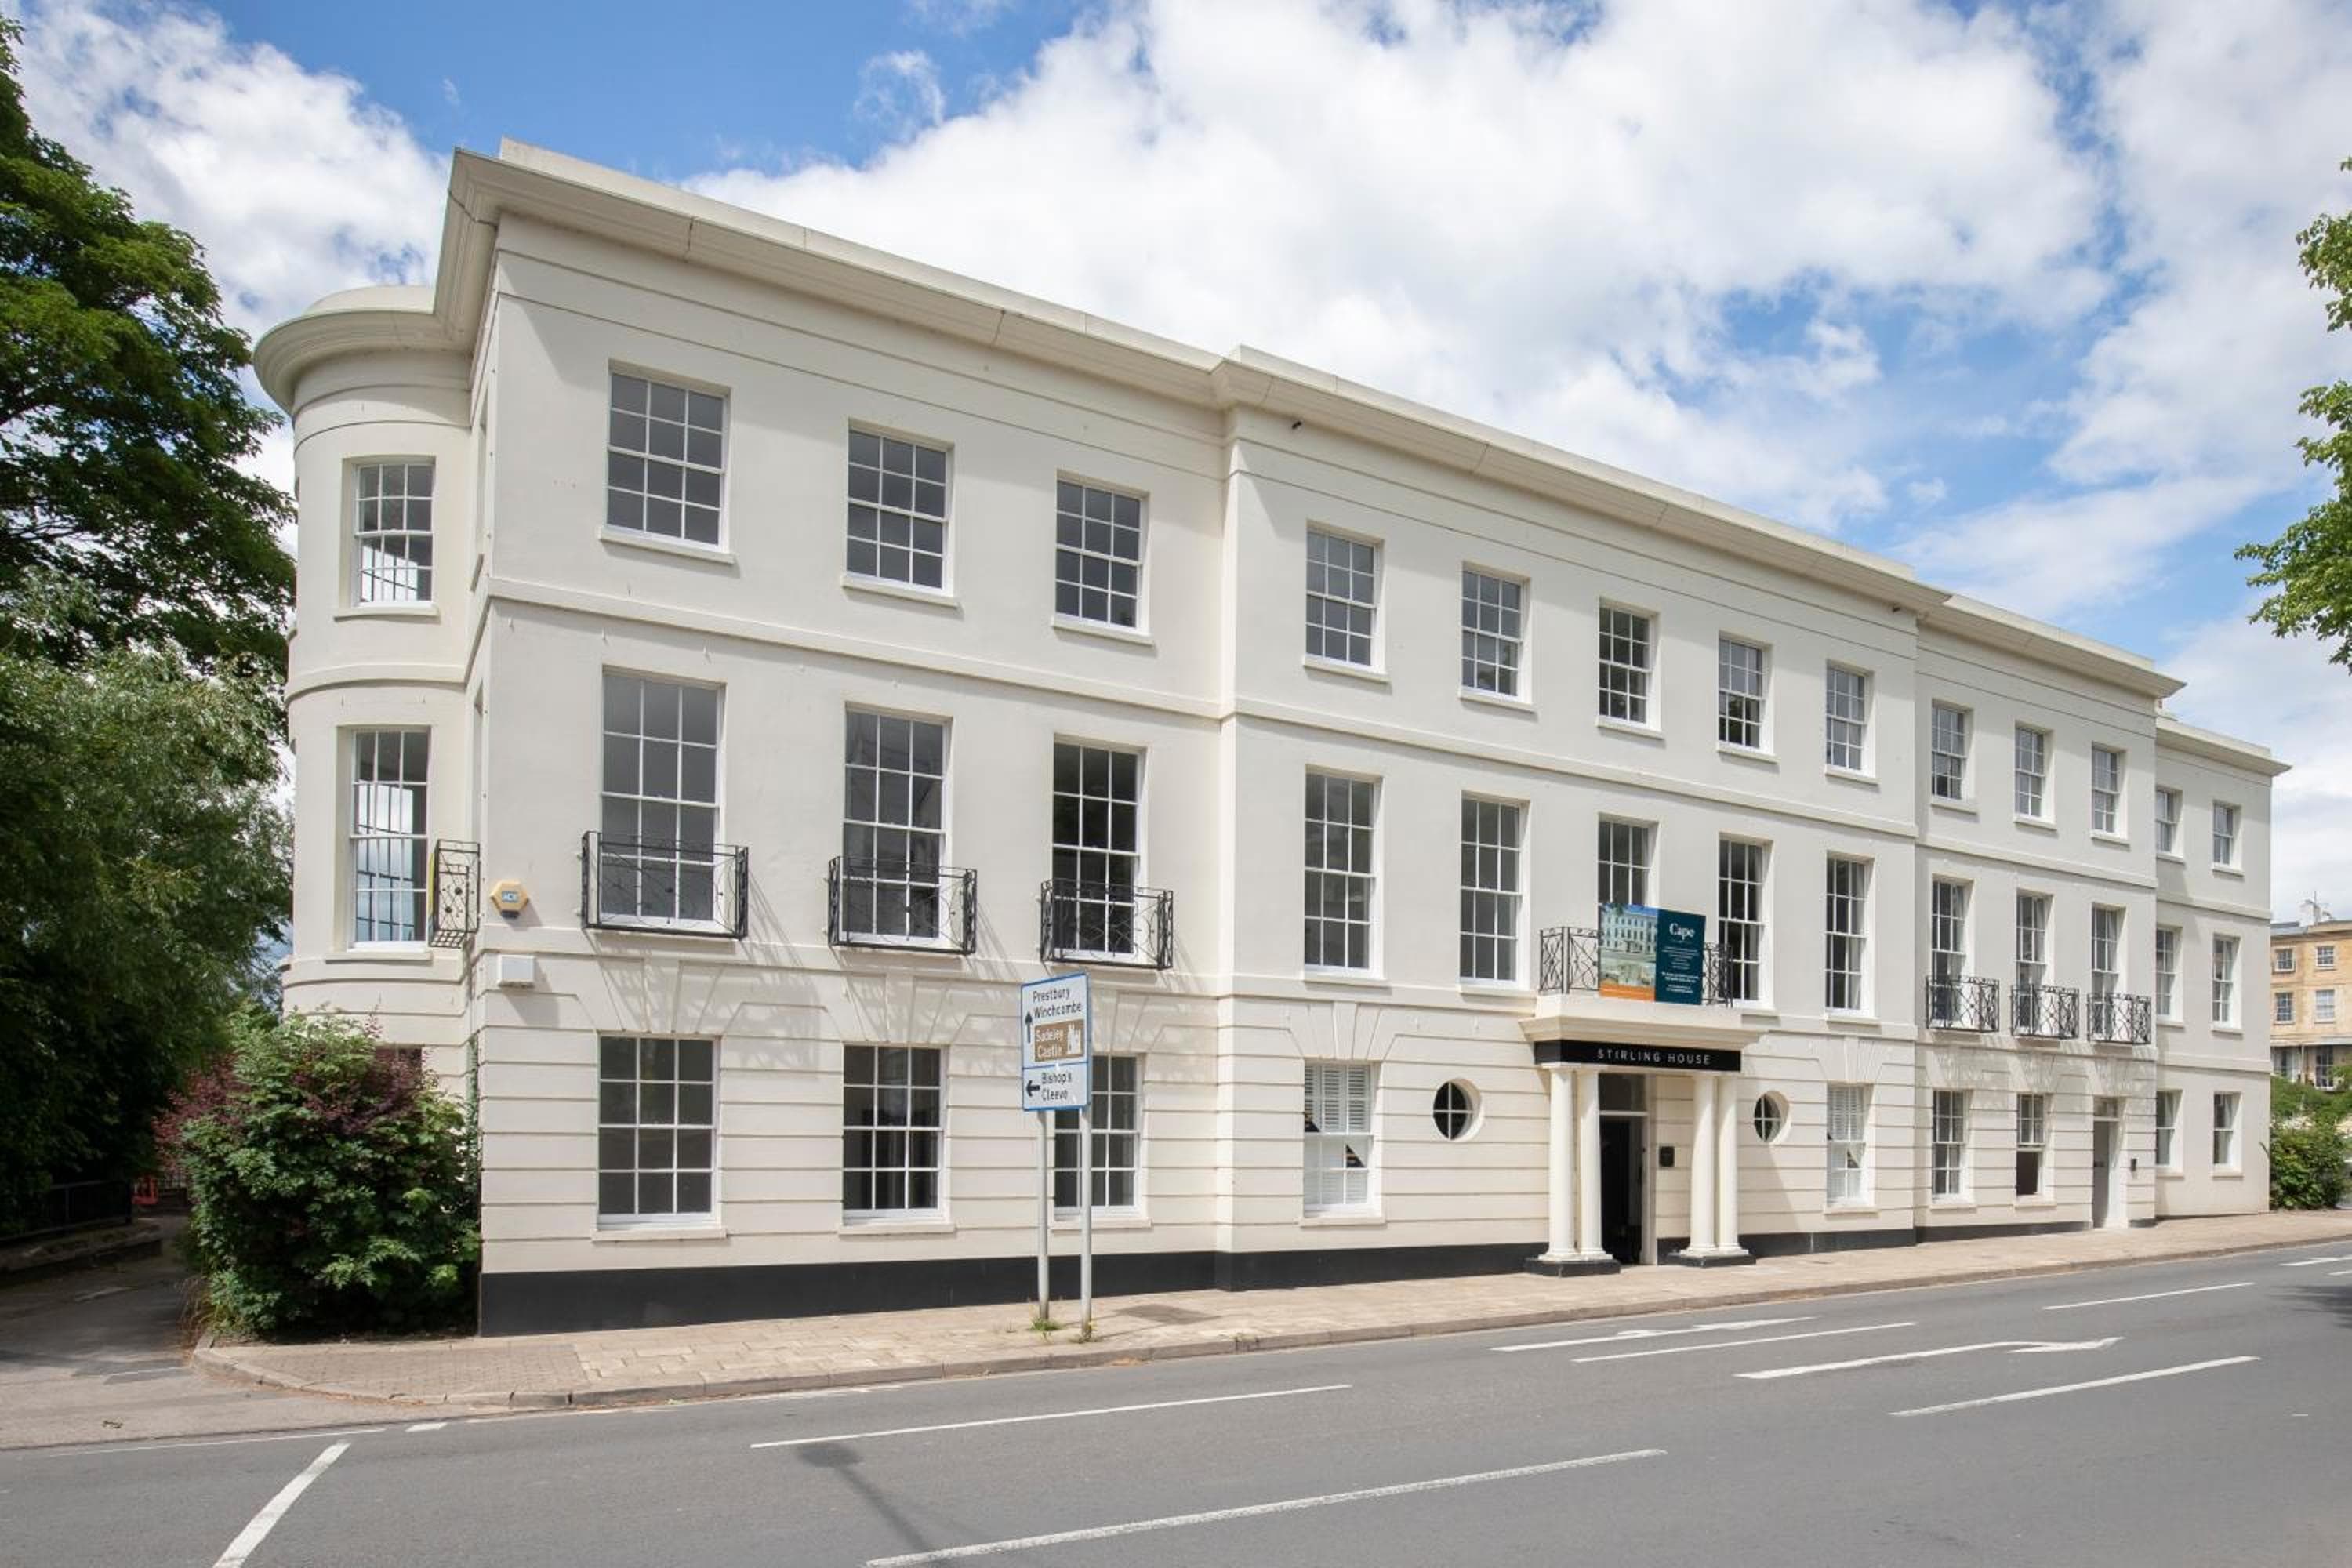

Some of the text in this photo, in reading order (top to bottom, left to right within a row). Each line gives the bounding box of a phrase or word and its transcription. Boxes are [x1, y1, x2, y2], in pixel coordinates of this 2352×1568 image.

[1669, 923, 1695, 940] Cape
[1033, 988, 1070, 1003] Prestbury
[1034, 1002, 1082, 1018] Winchcombe
[1037, 1044, 1062, 1058] Castle
[1597, 1048, 1711, 1065] STIRLING HOUSE
